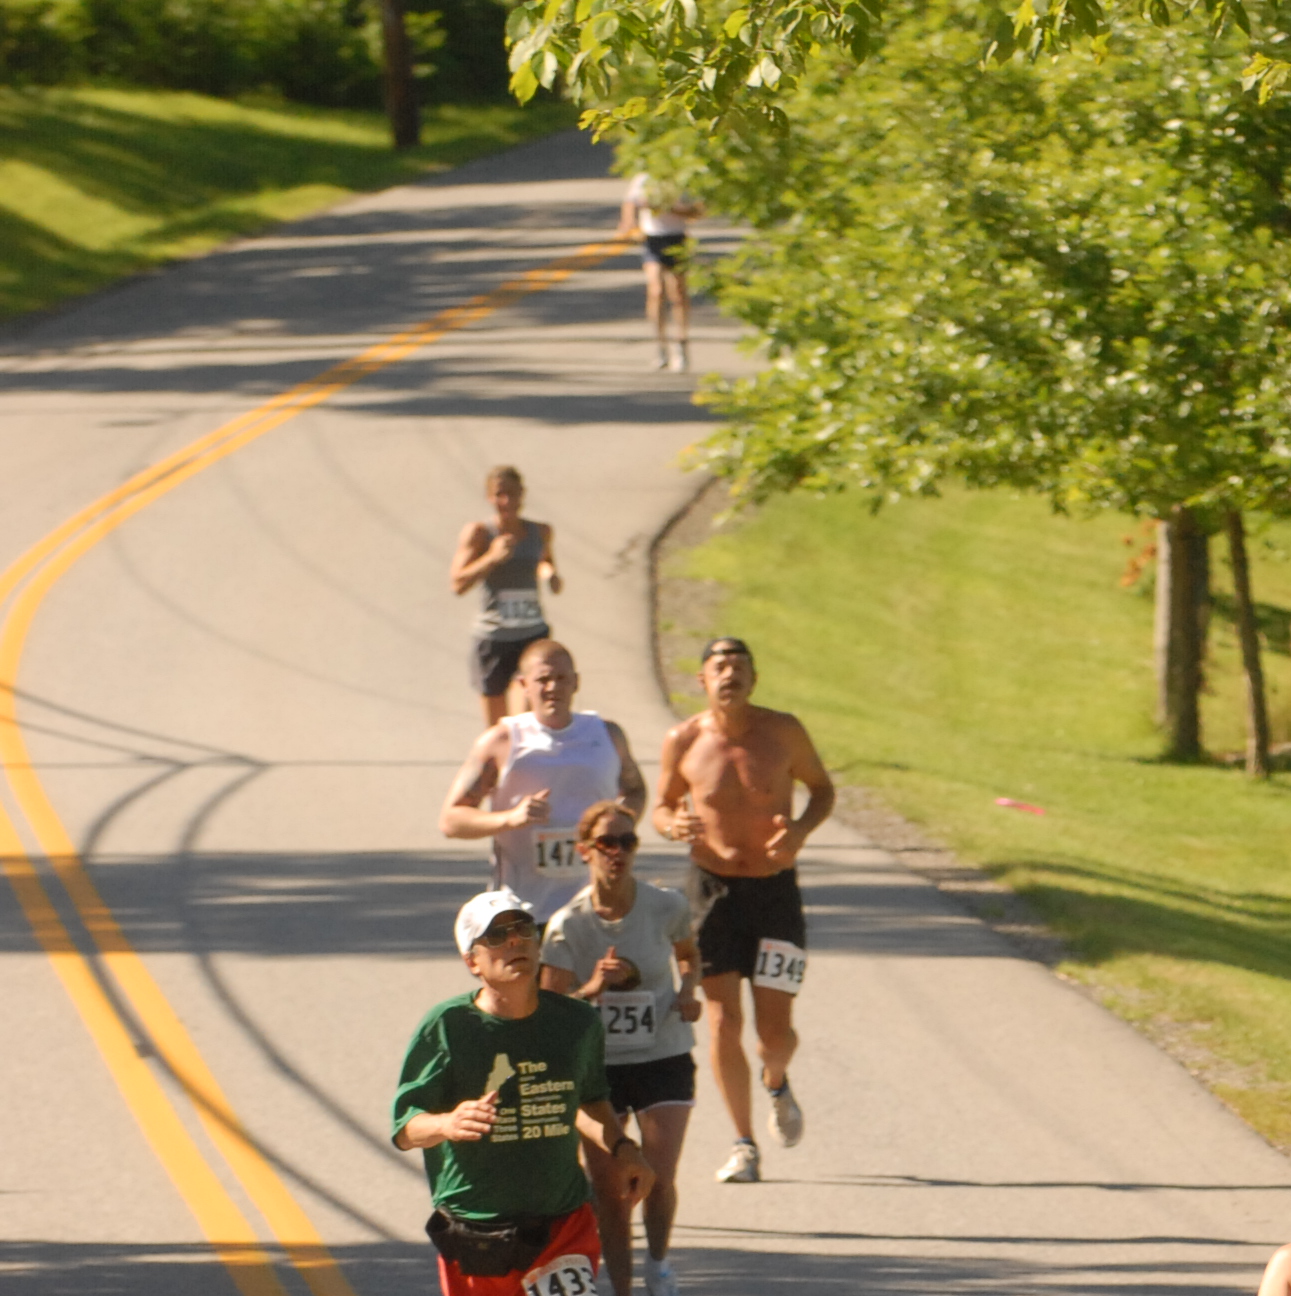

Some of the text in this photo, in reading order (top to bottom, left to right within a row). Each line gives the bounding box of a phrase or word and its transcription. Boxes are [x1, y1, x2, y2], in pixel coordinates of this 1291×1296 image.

[518, 1062, 547, 1074] The
[519, 1081, 575, 1096] Eastern
[520, 1103, 567, 1117] States
[522, 1122, 571, 1139] 20 Mile
